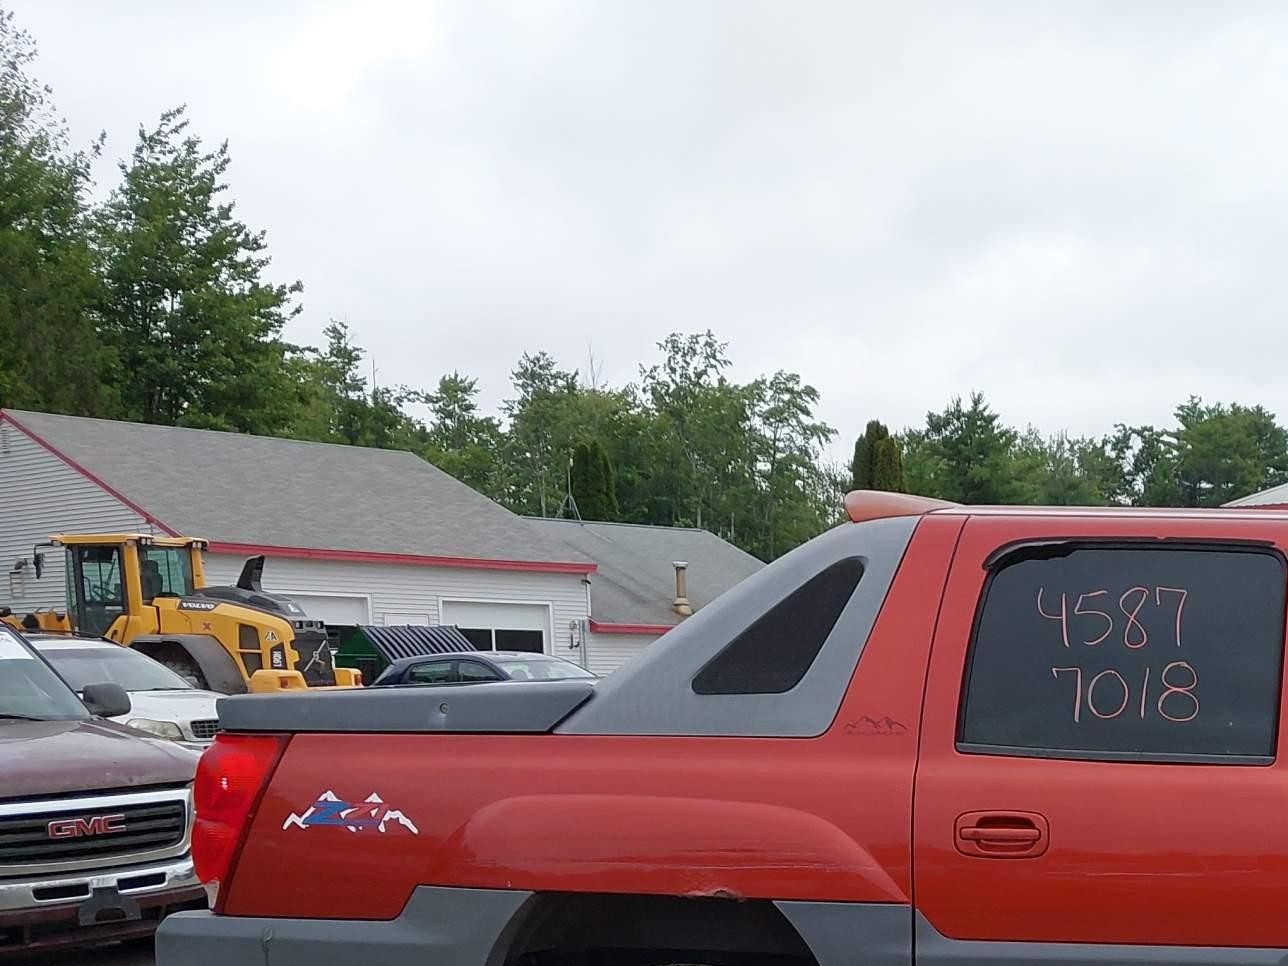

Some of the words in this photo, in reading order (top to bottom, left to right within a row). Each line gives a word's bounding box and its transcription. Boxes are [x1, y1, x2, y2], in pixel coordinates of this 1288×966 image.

[1037, 586, 1188, 649] 4587
[1051, 661, 1199, 722] 7018
[48, 814, 127, 839] GMC
